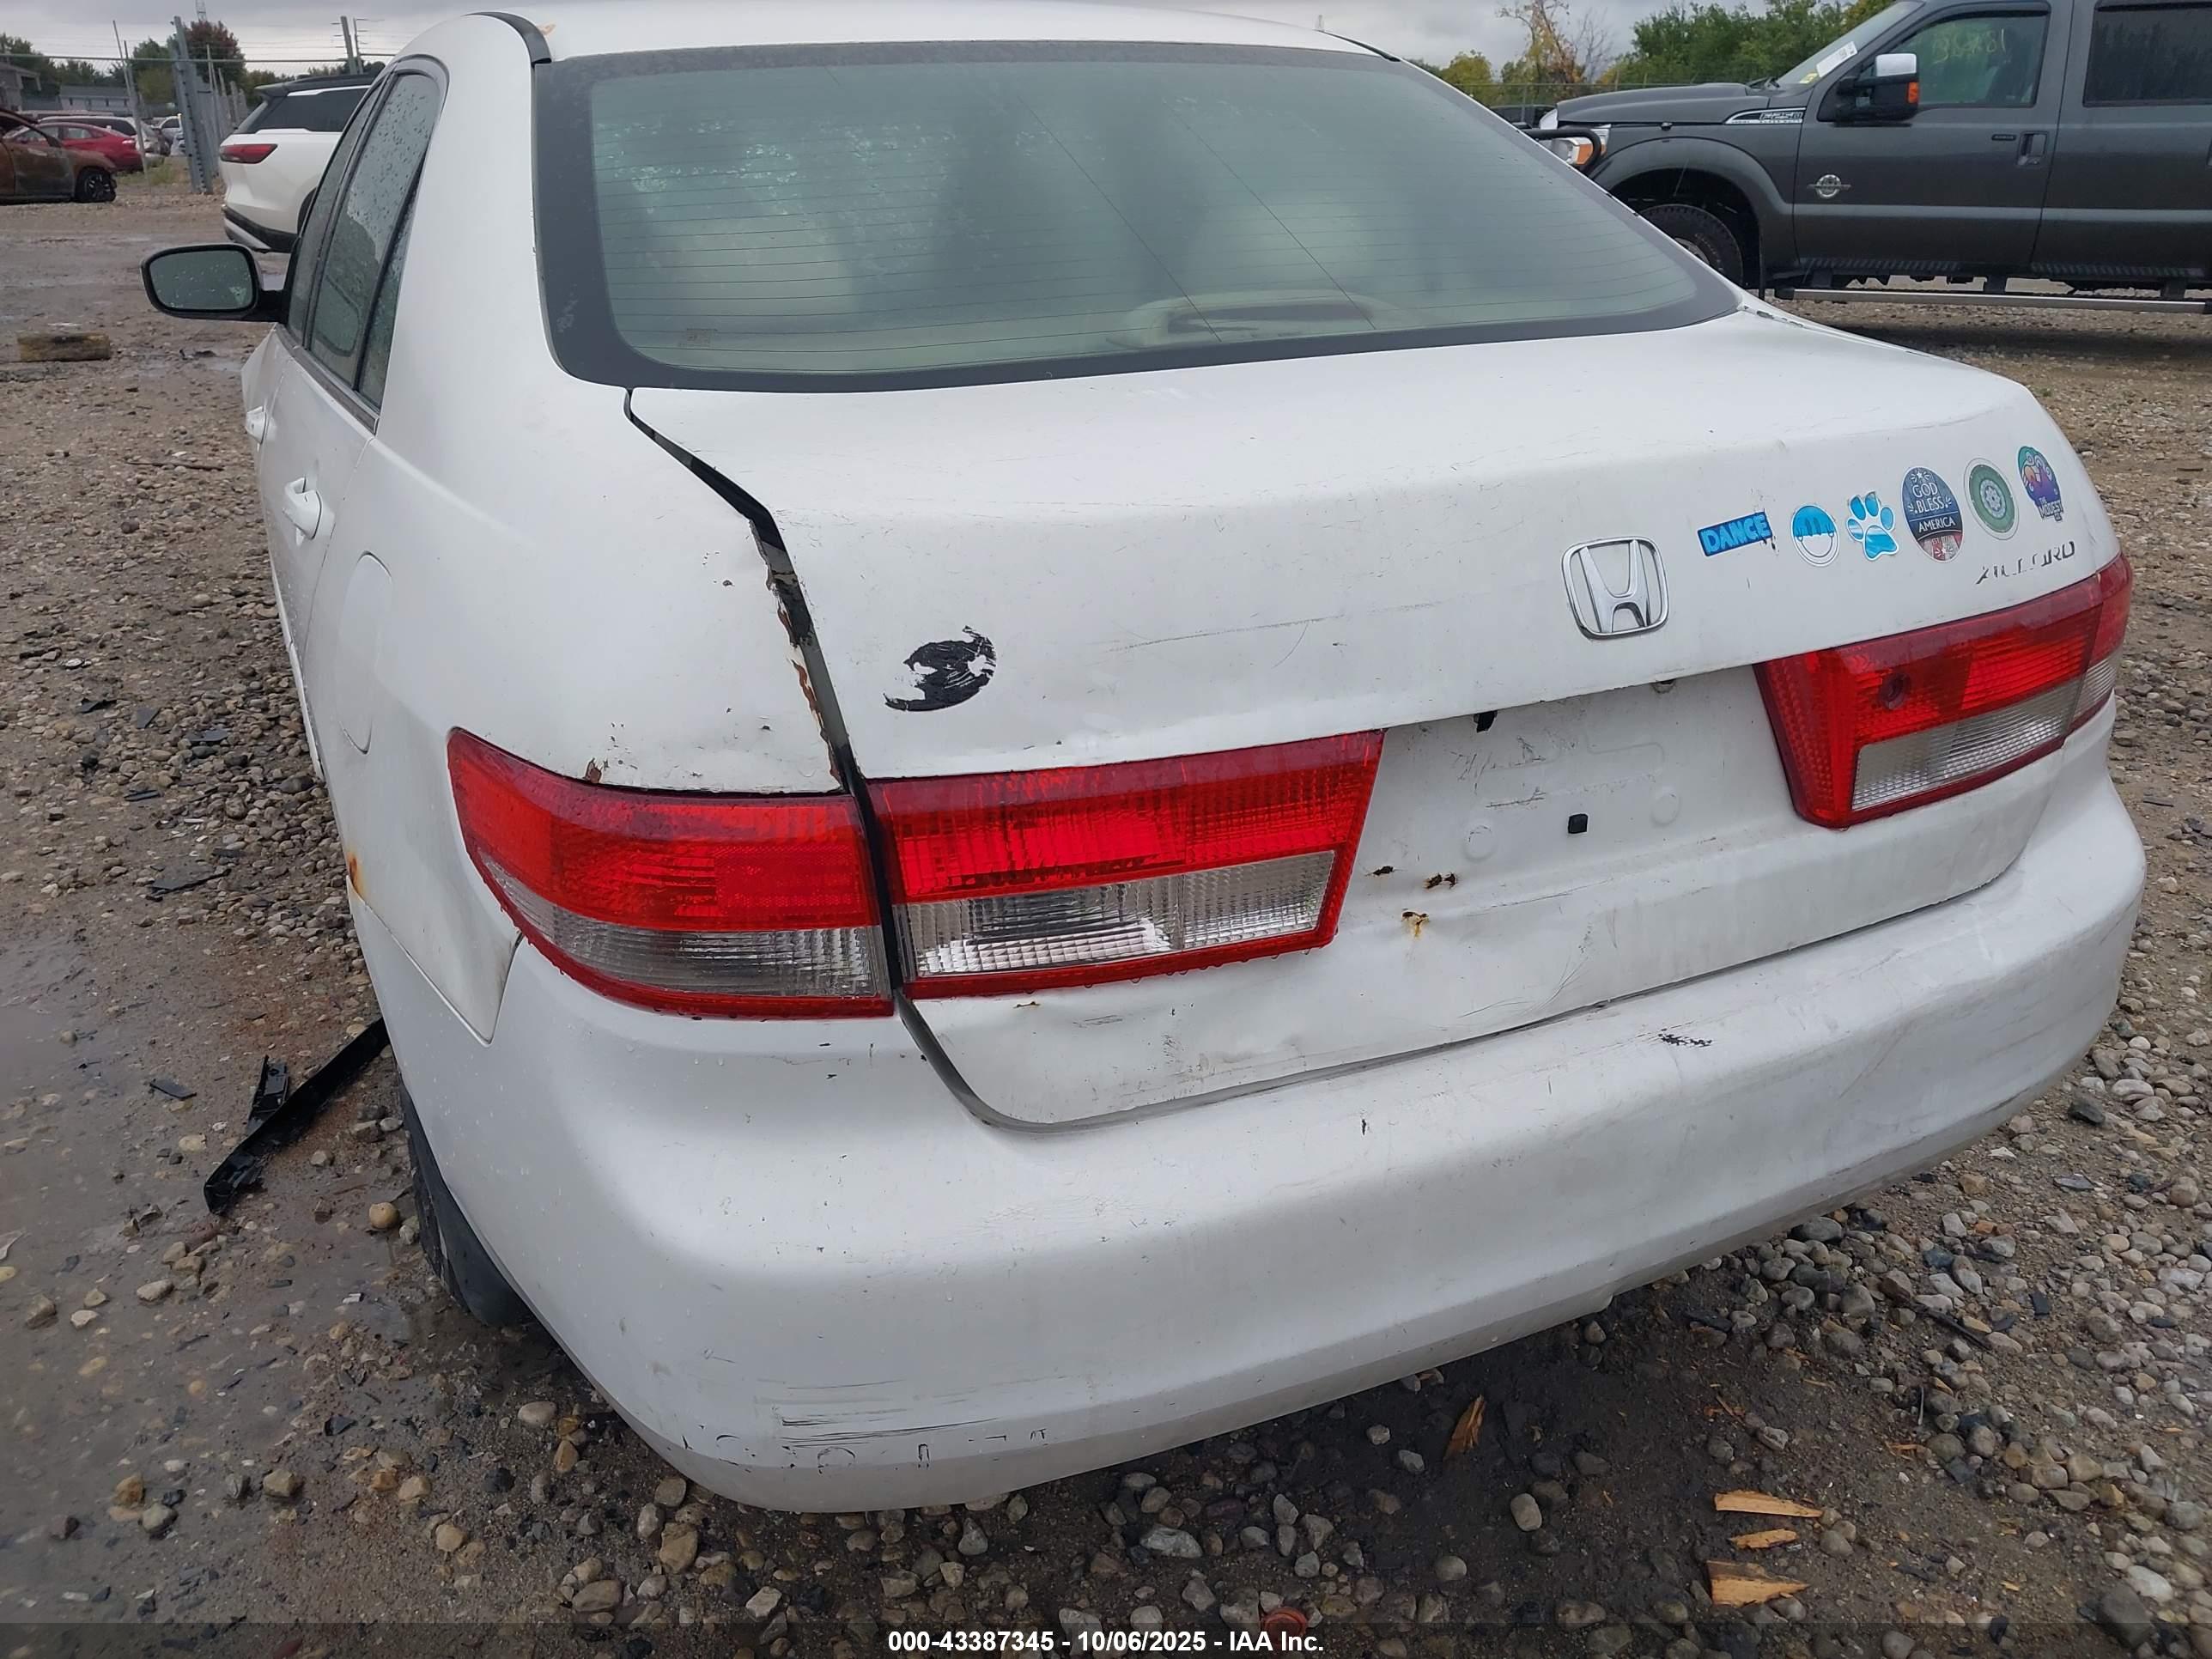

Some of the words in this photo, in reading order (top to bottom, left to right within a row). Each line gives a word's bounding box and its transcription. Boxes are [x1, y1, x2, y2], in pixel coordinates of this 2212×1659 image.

[1912, 482, 1938, 498] GOD
[1916, 495, 1945, 514] BLESS
[1918, 516, 1956, 533] AMERICA
[1700, 514, 1771, 554] DANCE
